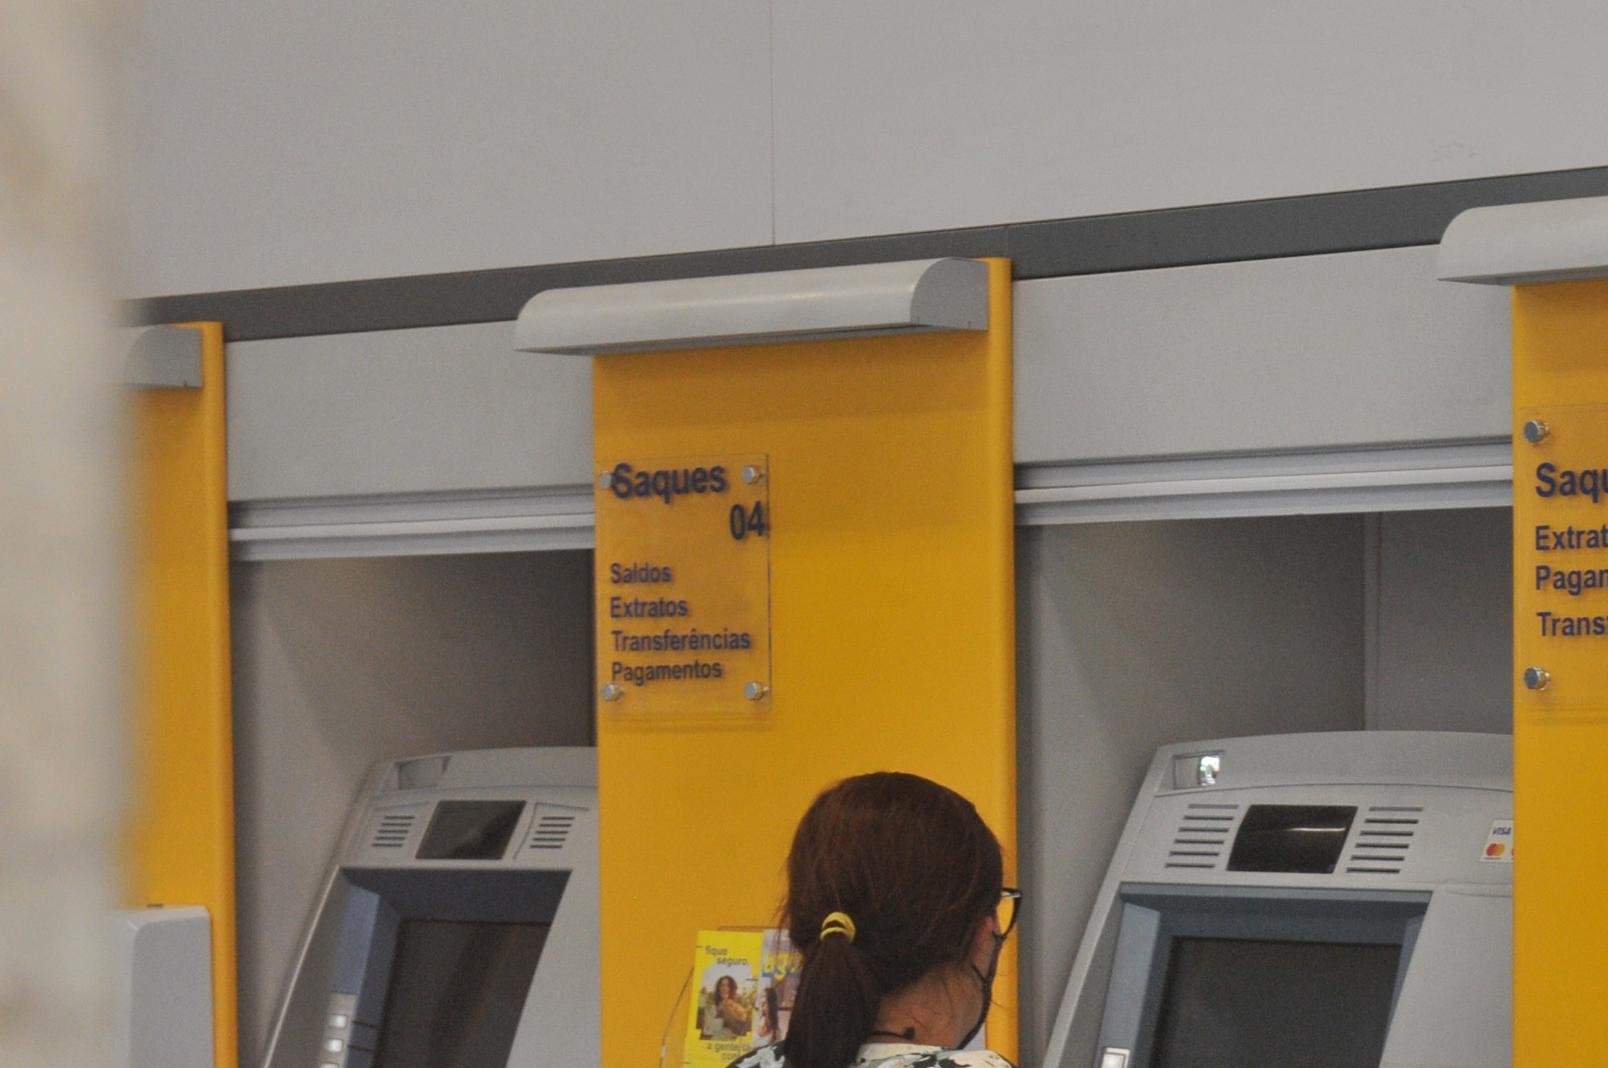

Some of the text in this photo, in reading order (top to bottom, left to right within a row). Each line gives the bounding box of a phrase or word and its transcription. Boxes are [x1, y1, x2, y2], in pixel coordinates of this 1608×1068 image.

[611, 463, 729, 504] Saques
[730, 501, 767, 540] 04
[610, 562, 672, 584] Saldos
[610, 596, 688, 619] Extratos
[611, 628, 752, 652] Transferências
[611, 660, 722, 686] Pagamentos
